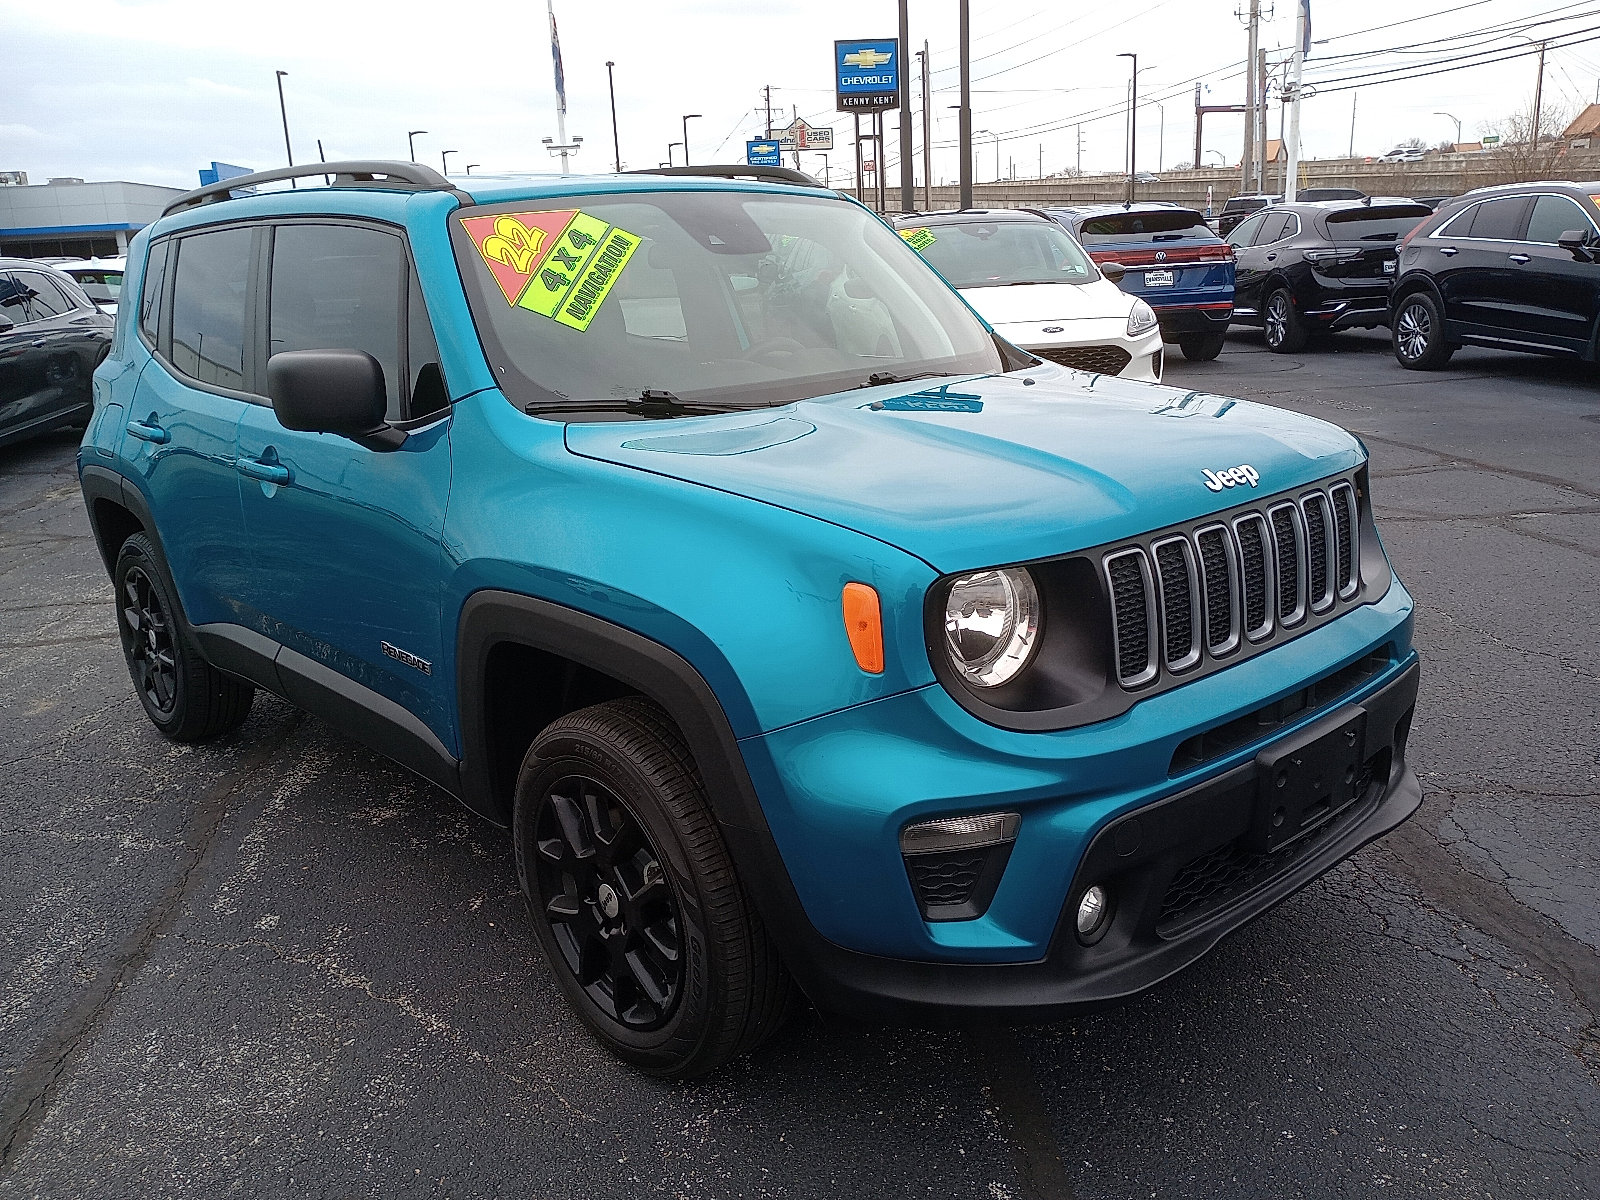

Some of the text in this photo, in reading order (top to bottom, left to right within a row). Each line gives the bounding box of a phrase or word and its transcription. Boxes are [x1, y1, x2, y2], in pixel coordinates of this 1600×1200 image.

[841, 75, 894, 85] CHEVROLET
[842, 96, 894, 106] KENNY KENT
[481, 216, 549, 275] 22
[565, 234, 633, 322] NAVIGATION
[1200, 464, 1260, 493] Jeep
[381, 640, 433, 676] RENEGADE
